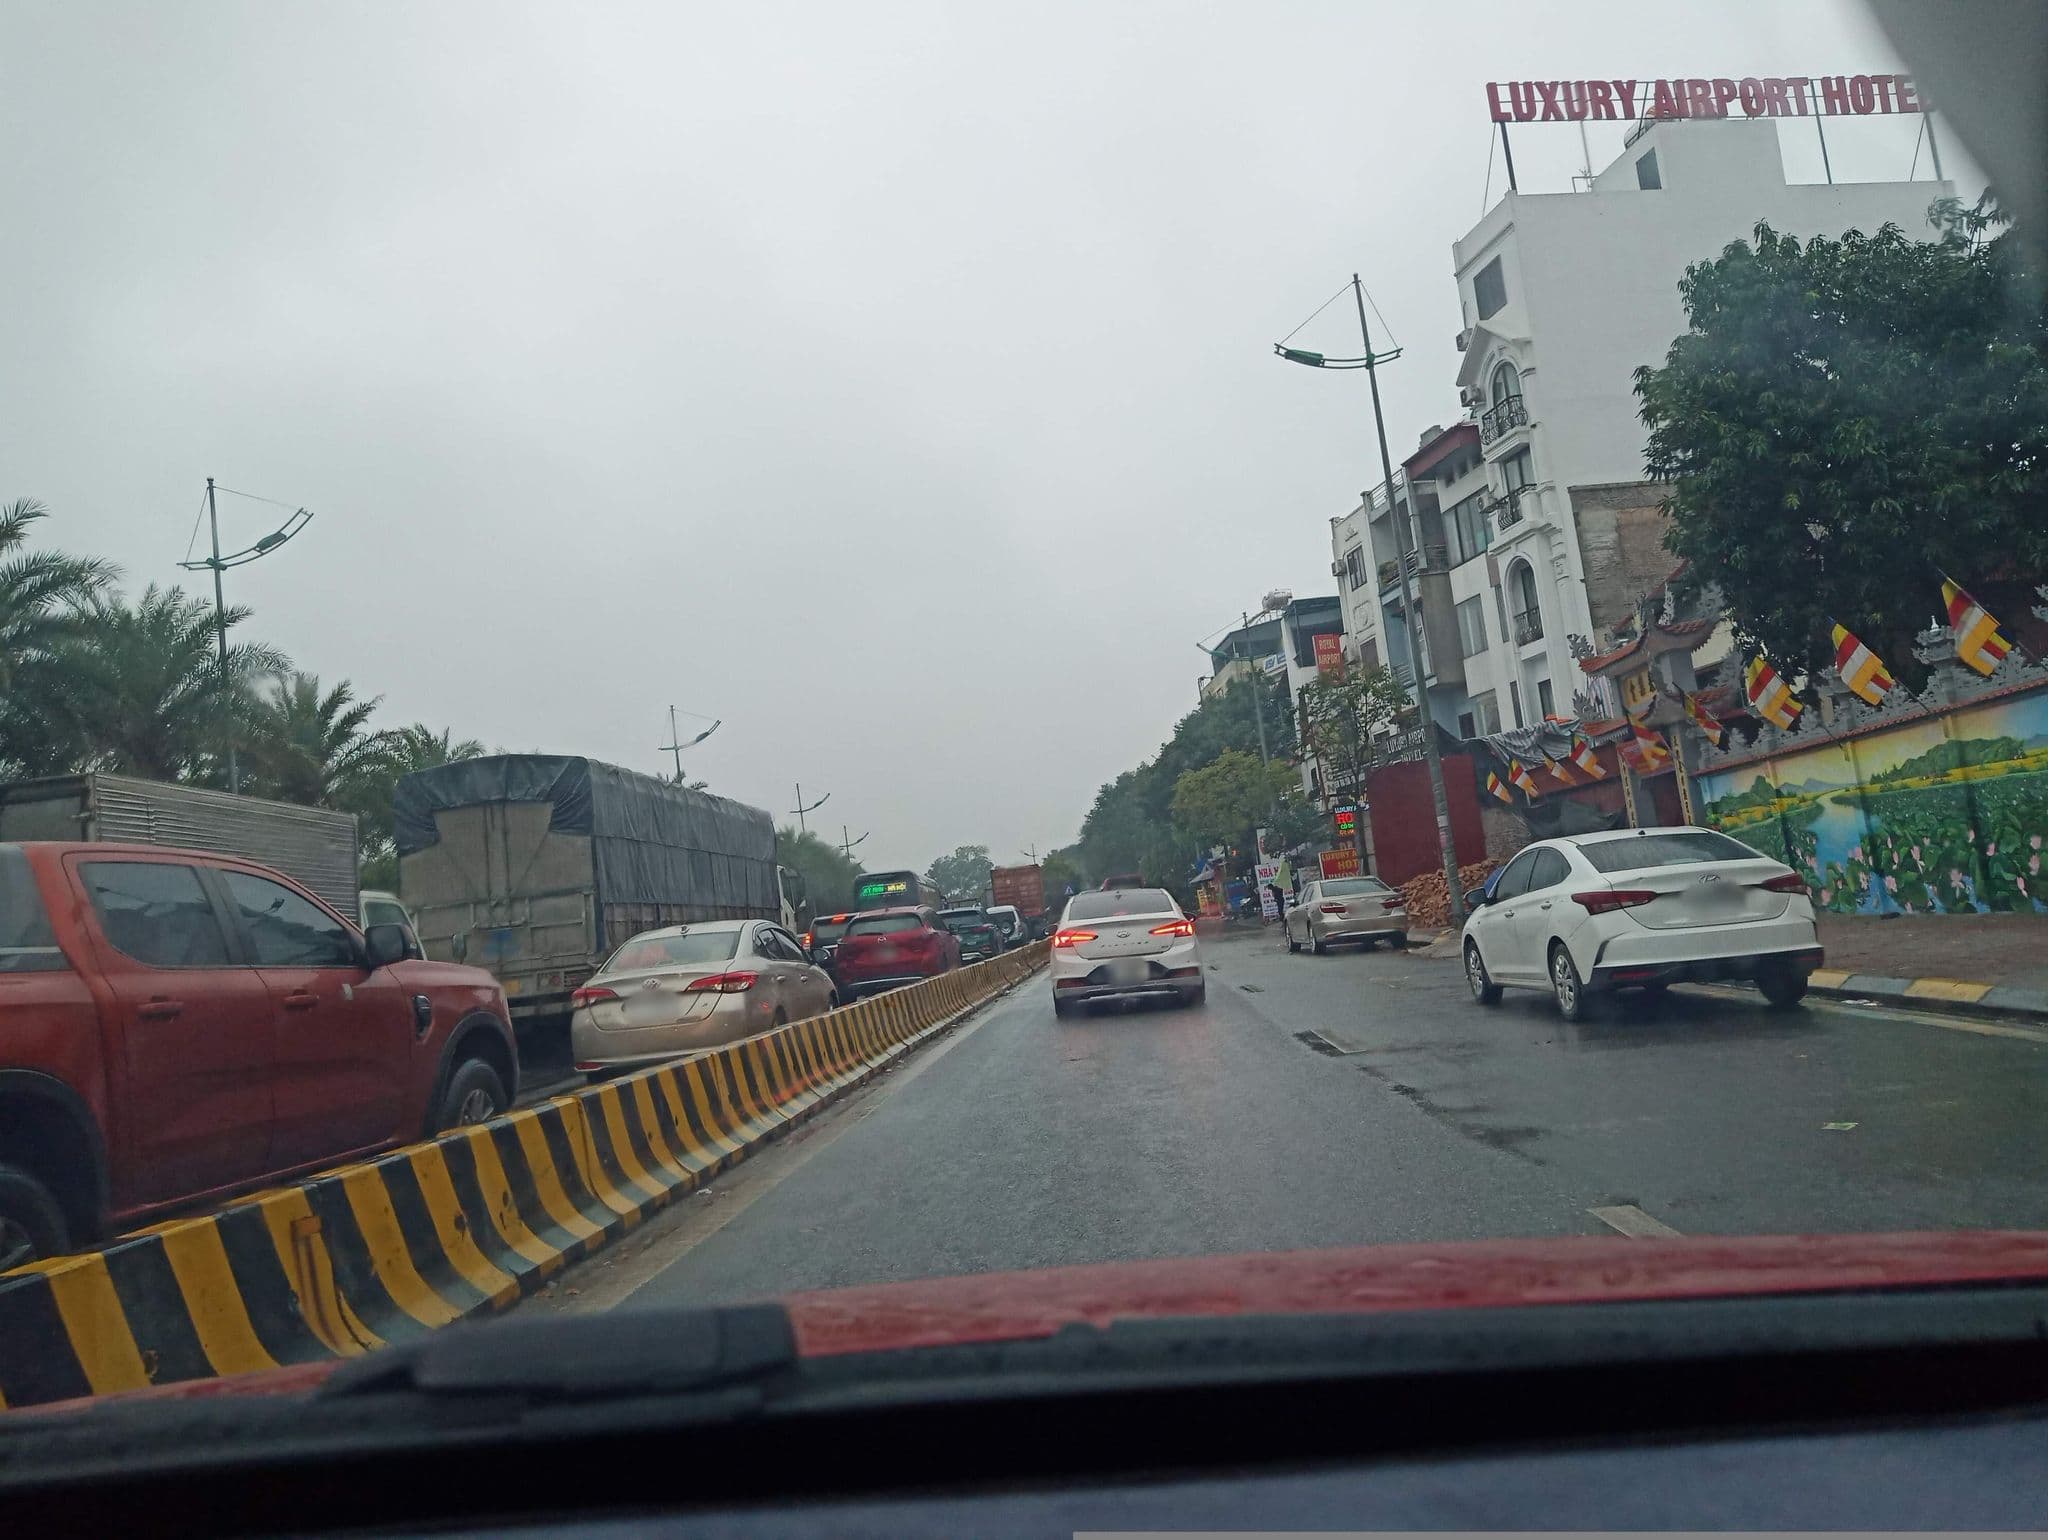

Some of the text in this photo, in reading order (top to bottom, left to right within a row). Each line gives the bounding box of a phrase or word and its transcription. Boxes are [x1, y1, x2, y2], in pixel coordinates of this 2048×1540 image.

[1486, 74, 1928, 123] LUXURY AIRPORT HOTE
[1318, 653, 1341, 665] AIRPORT
